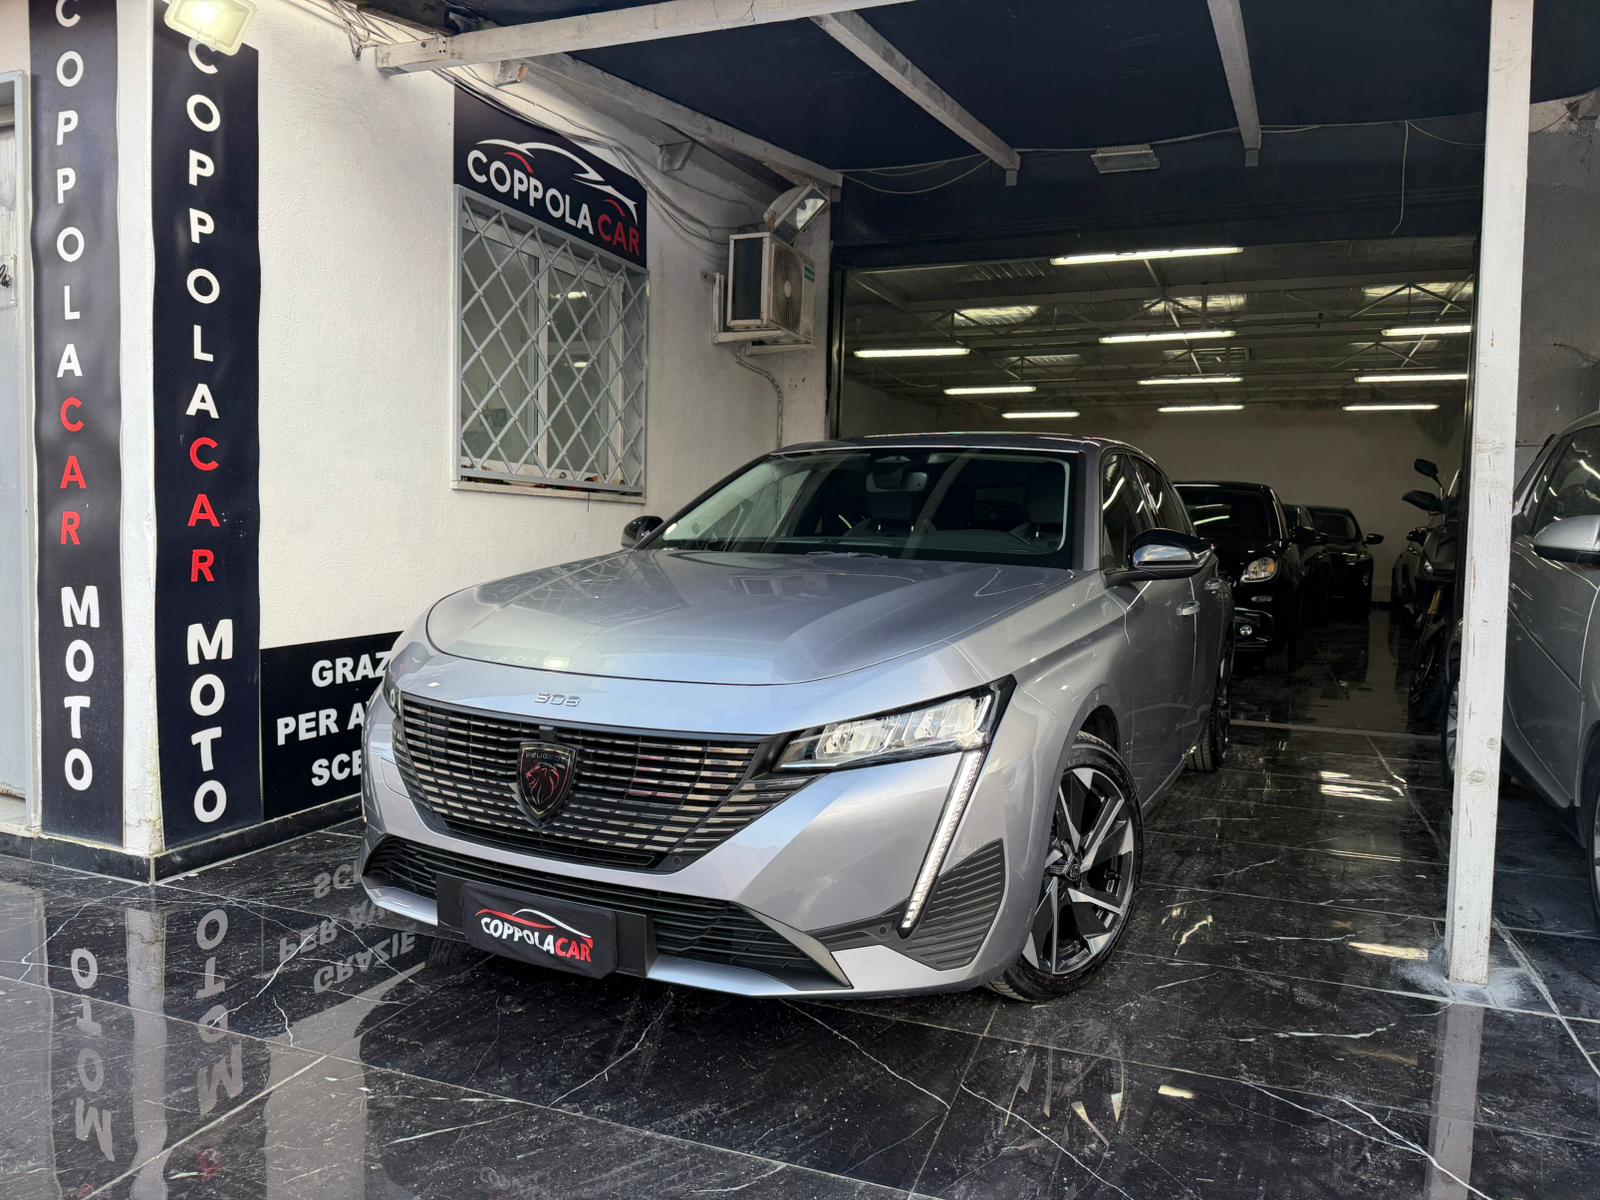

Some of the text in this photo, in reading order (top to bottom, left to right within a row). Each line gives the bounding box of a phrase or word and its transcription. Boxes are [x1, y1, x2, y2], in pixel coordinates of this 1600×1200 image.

[61, 585, 100, 791] MOTO
[186, 618, 234, 823] MOTO
[277, 708, 339, 746] PER
[535, 690, 581, 707] 308
